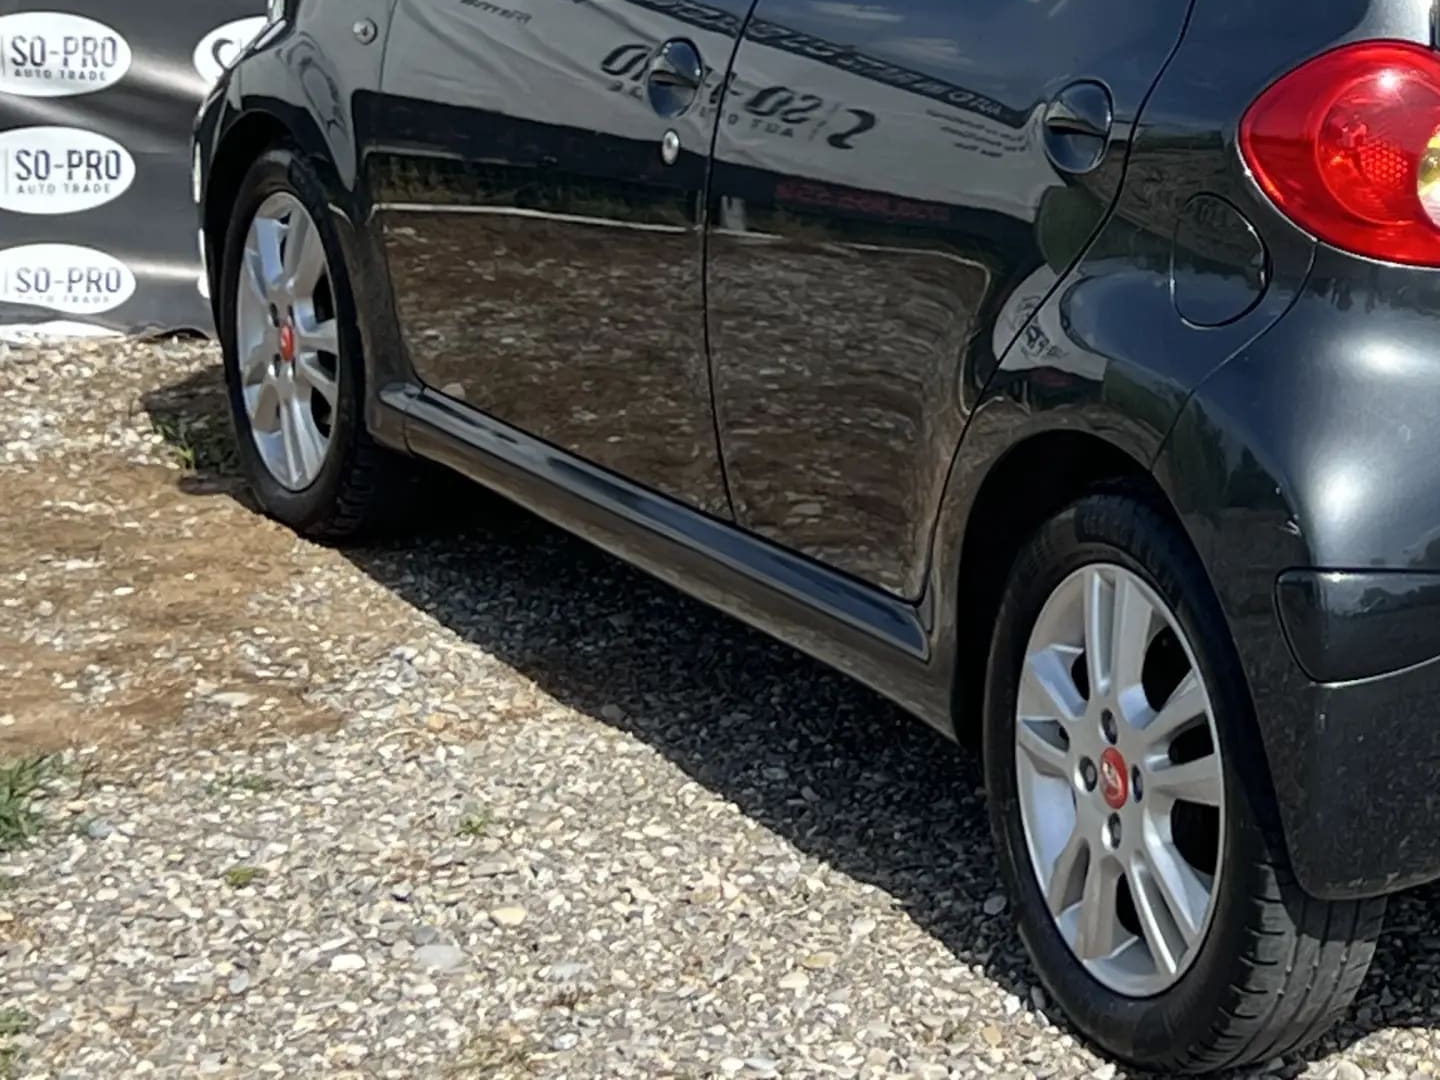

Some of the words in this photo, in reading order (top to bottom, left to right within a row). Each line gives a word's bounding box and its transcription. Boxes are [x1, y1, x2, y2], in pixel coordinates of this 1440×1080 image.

[11, 35, 117, 68] SO-PRO
[15, 149, 121, 181] SO-PRO
[15, 266, 121, 293] SO-PRO
